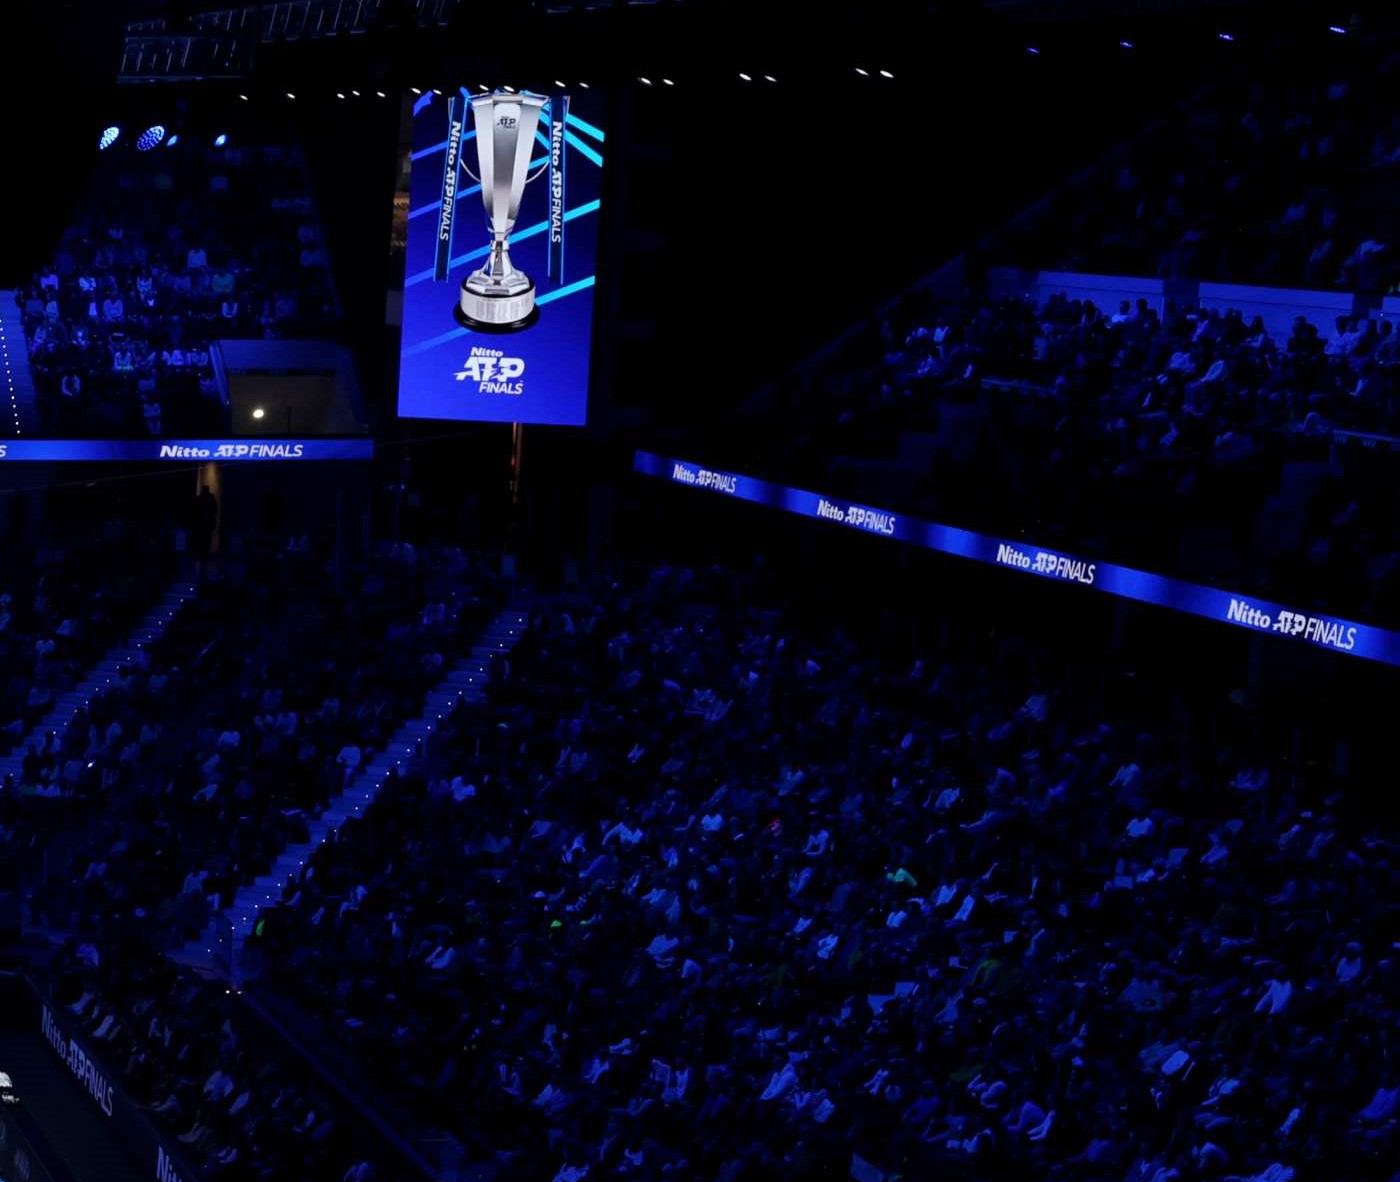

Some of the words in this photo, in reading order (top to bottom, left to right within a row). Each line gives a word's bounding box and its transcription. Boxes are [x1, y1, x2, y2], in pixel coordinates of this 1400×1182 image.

[448, 121, 461, 166] Nitto
[552, 121, 562, 165] Nitto
[440, 197, 452, 241] FINALS
[551, 199, 561, 243] FINALS
[454, 356, 525, 382] ATP
[471, 347, 503, 357] Nitto
[479, 381, 523, 394] FINALS
[160, 446, 210, 457] Nitto
[250, 445, 303, 457] FINALS
[673, 464, 696, 484] Nitto
[712, 473, 736, 494] FINALS
[817, 500, 845, 522] Nitto
[865, 510, 895, 535] FINALS
[997, 544, 1032, 569] Nitto
[1056, 557, 1096, 584] FINALS
[1227, 599, 1271, 630] Nitto
[1304, 617, 1357, 651] FINALS
